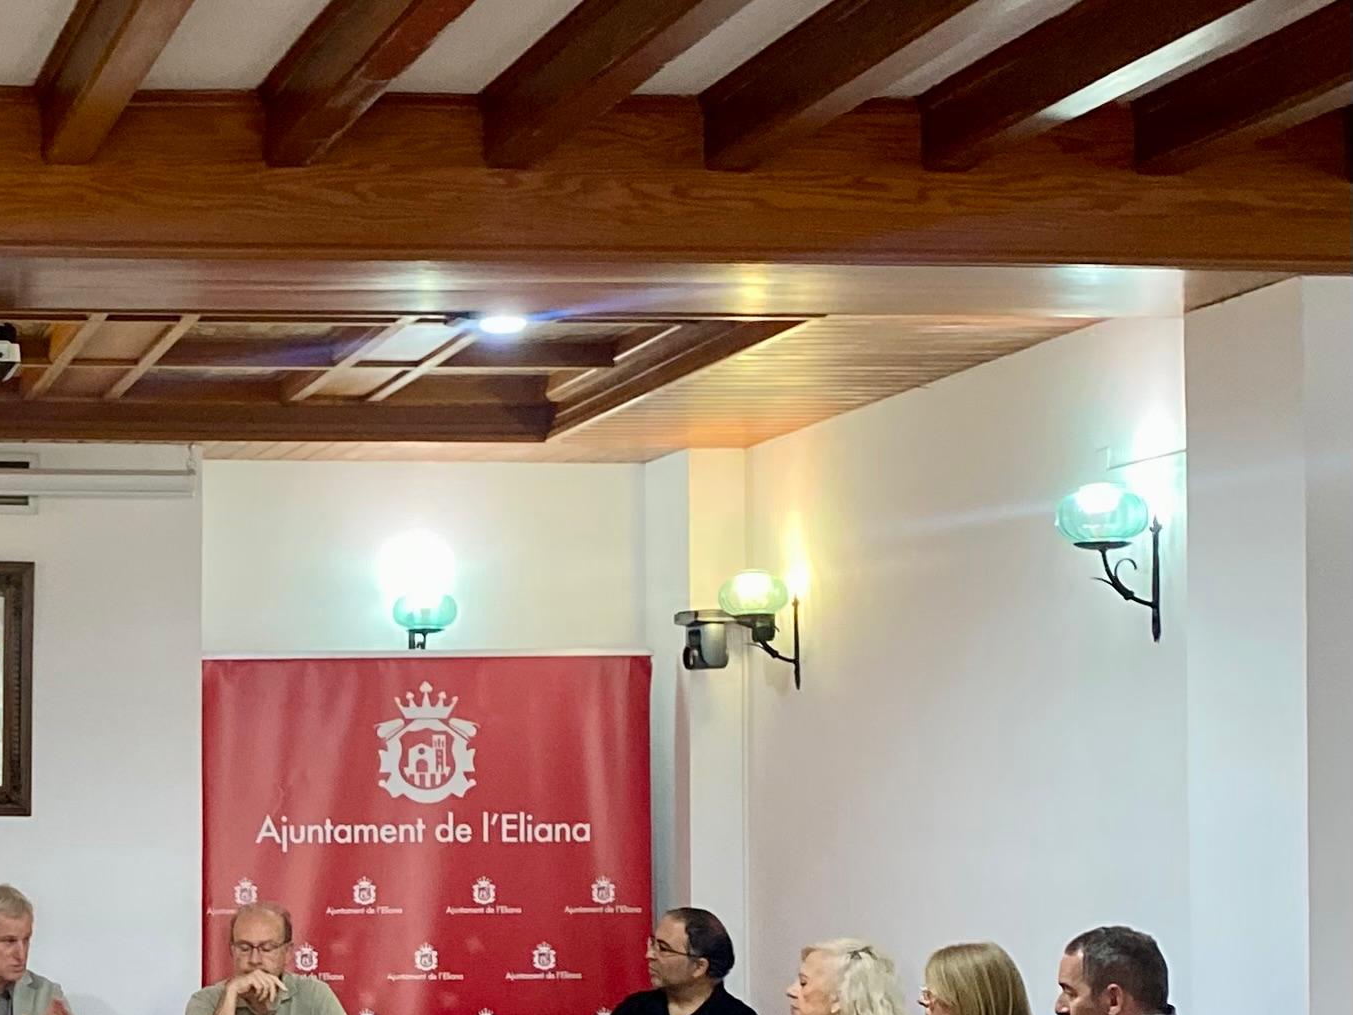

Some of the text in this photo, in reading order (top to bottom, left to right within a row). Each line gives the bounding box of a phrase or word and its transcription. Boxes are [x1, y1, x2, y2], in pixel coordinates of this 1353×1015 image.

[255, 810, 591, 853] Ajuntament de l'Eliana
